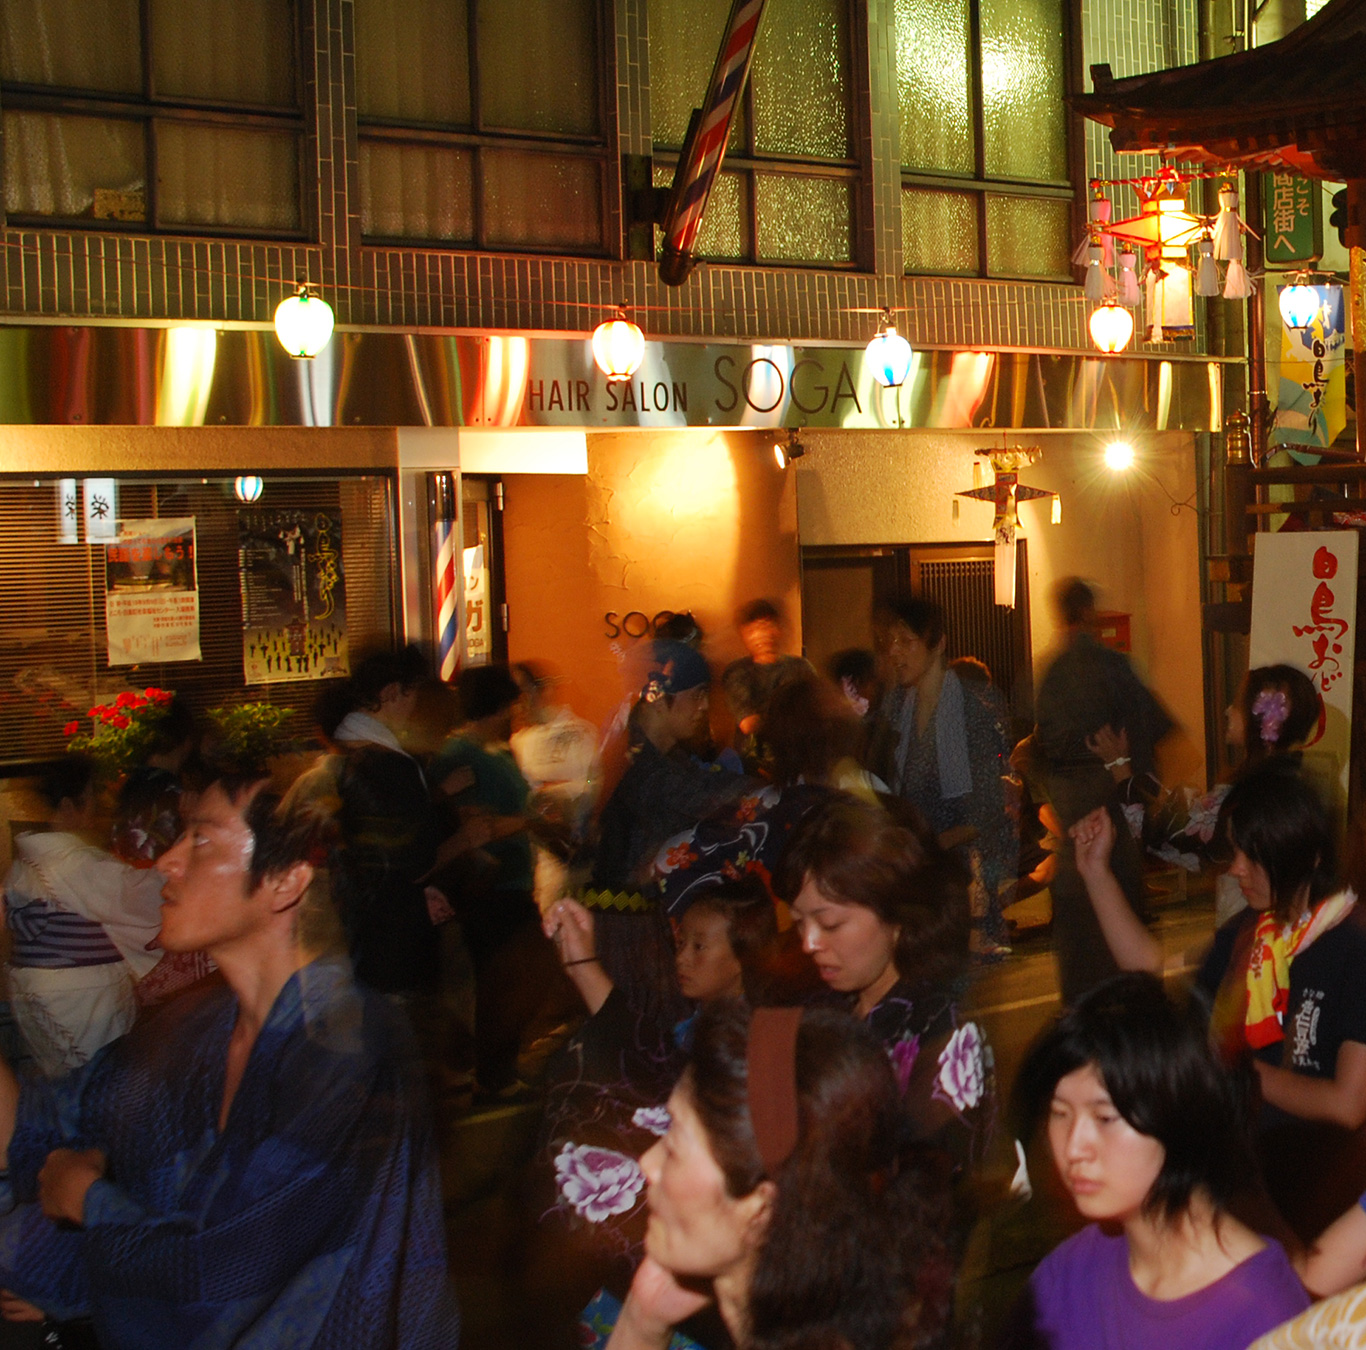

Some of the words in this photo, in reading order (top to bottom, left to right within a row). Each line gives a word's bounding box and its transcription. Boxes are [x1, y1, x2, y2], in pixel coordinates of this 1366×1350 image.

[528, 379, 591, 412] HAIR
[605, 380, 688, 412] SALON
[714, 355, 863, 414] SOGA
